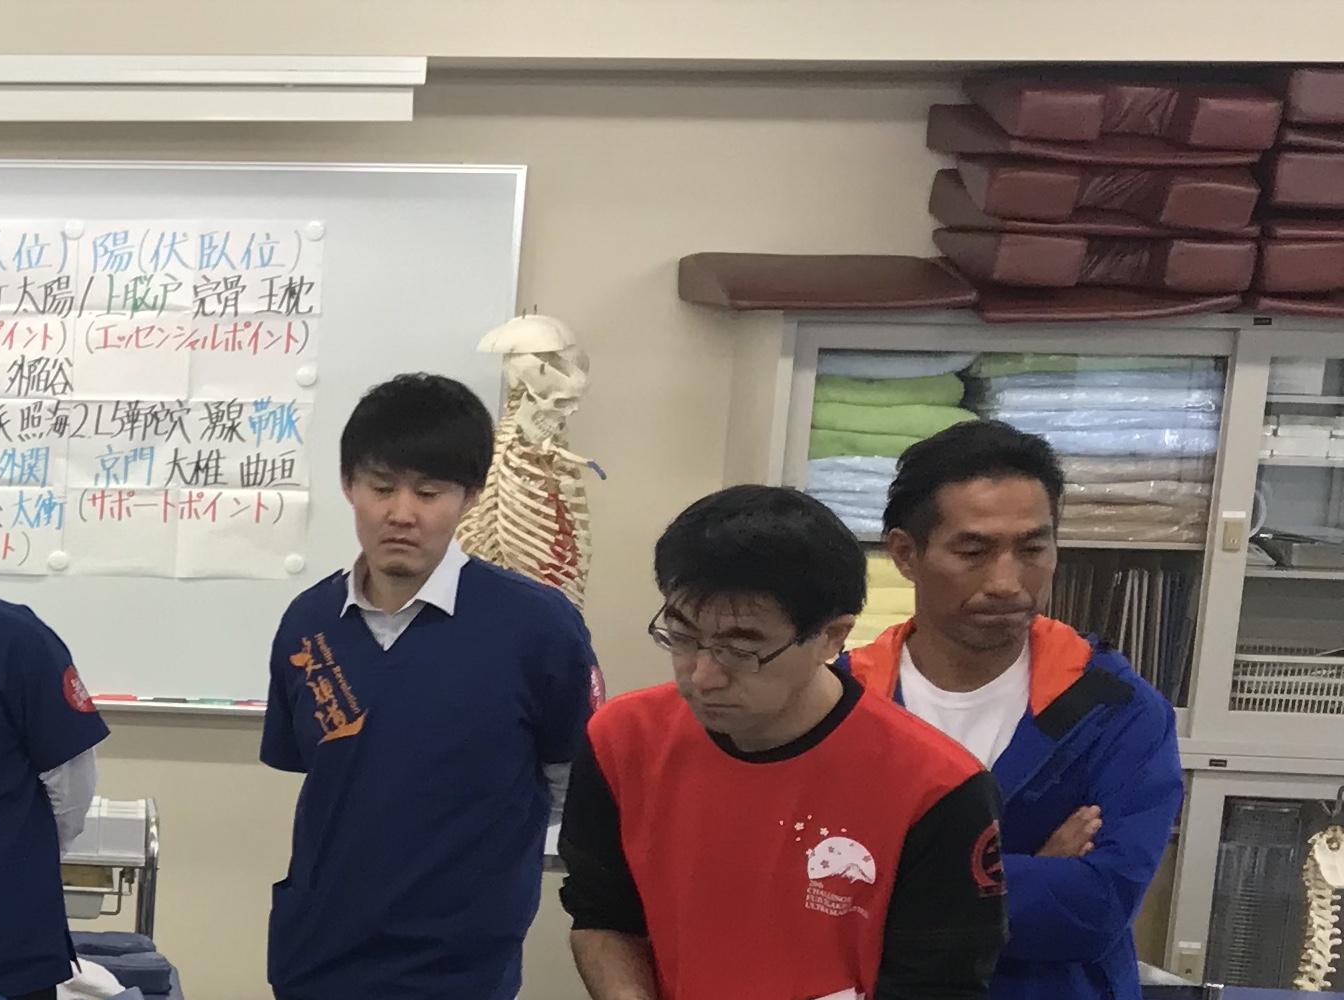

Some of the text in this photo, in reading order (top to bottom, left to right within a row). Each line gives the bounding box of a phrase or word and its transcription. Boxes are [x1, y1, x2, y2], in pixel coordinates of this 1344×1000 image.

[11, 275, 76, 319] 太陽
[192, 275, 247, 320] 完骨
[19, 400, 70, 442] 照海
[94, 444, 156, 489] 京門
[165, 447, 229, 487] 大椎
